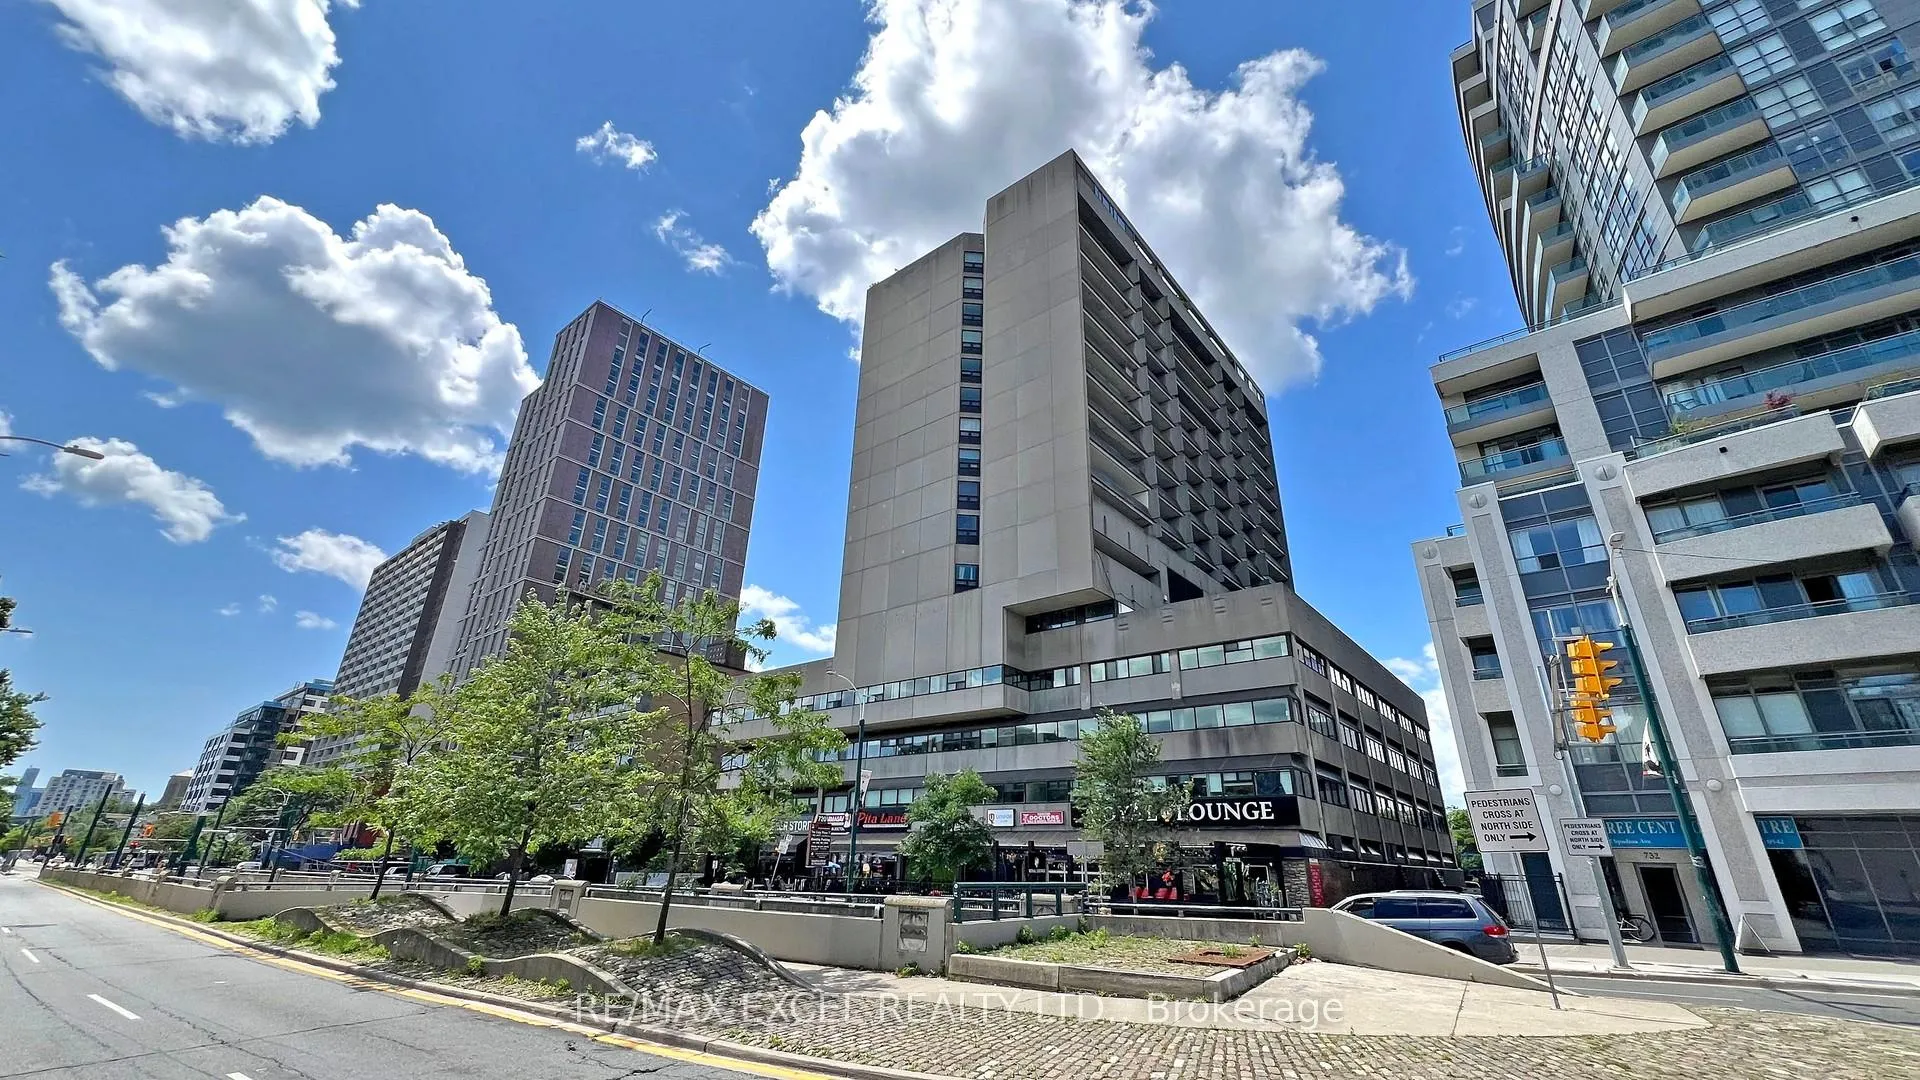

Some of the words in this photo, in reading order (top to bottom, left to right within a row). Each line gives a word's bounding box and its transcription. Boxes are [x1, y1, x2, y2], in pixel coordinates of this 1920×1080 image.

[1471, 797, 1531, 808] PEDESTRIANS
[1177, 801, 1275, 821] LOUNGE
[1482, 809, 1512, 819] CROSS
[1514, 809, 1525, 818] AT
[857, 811, 878, 826] Pita
[1480, 821, 1511, 831] NORTH
[1513, 820, 1534, 830] SIDE
[1606, 821, 1635, 834] REE
[1638, 821, 1677, 834] CENT
[1759, 820, 1795, 834] TRE
[1484, 833, 1507, 843] ONLY
[1643, 851, 1661, 860] 732
